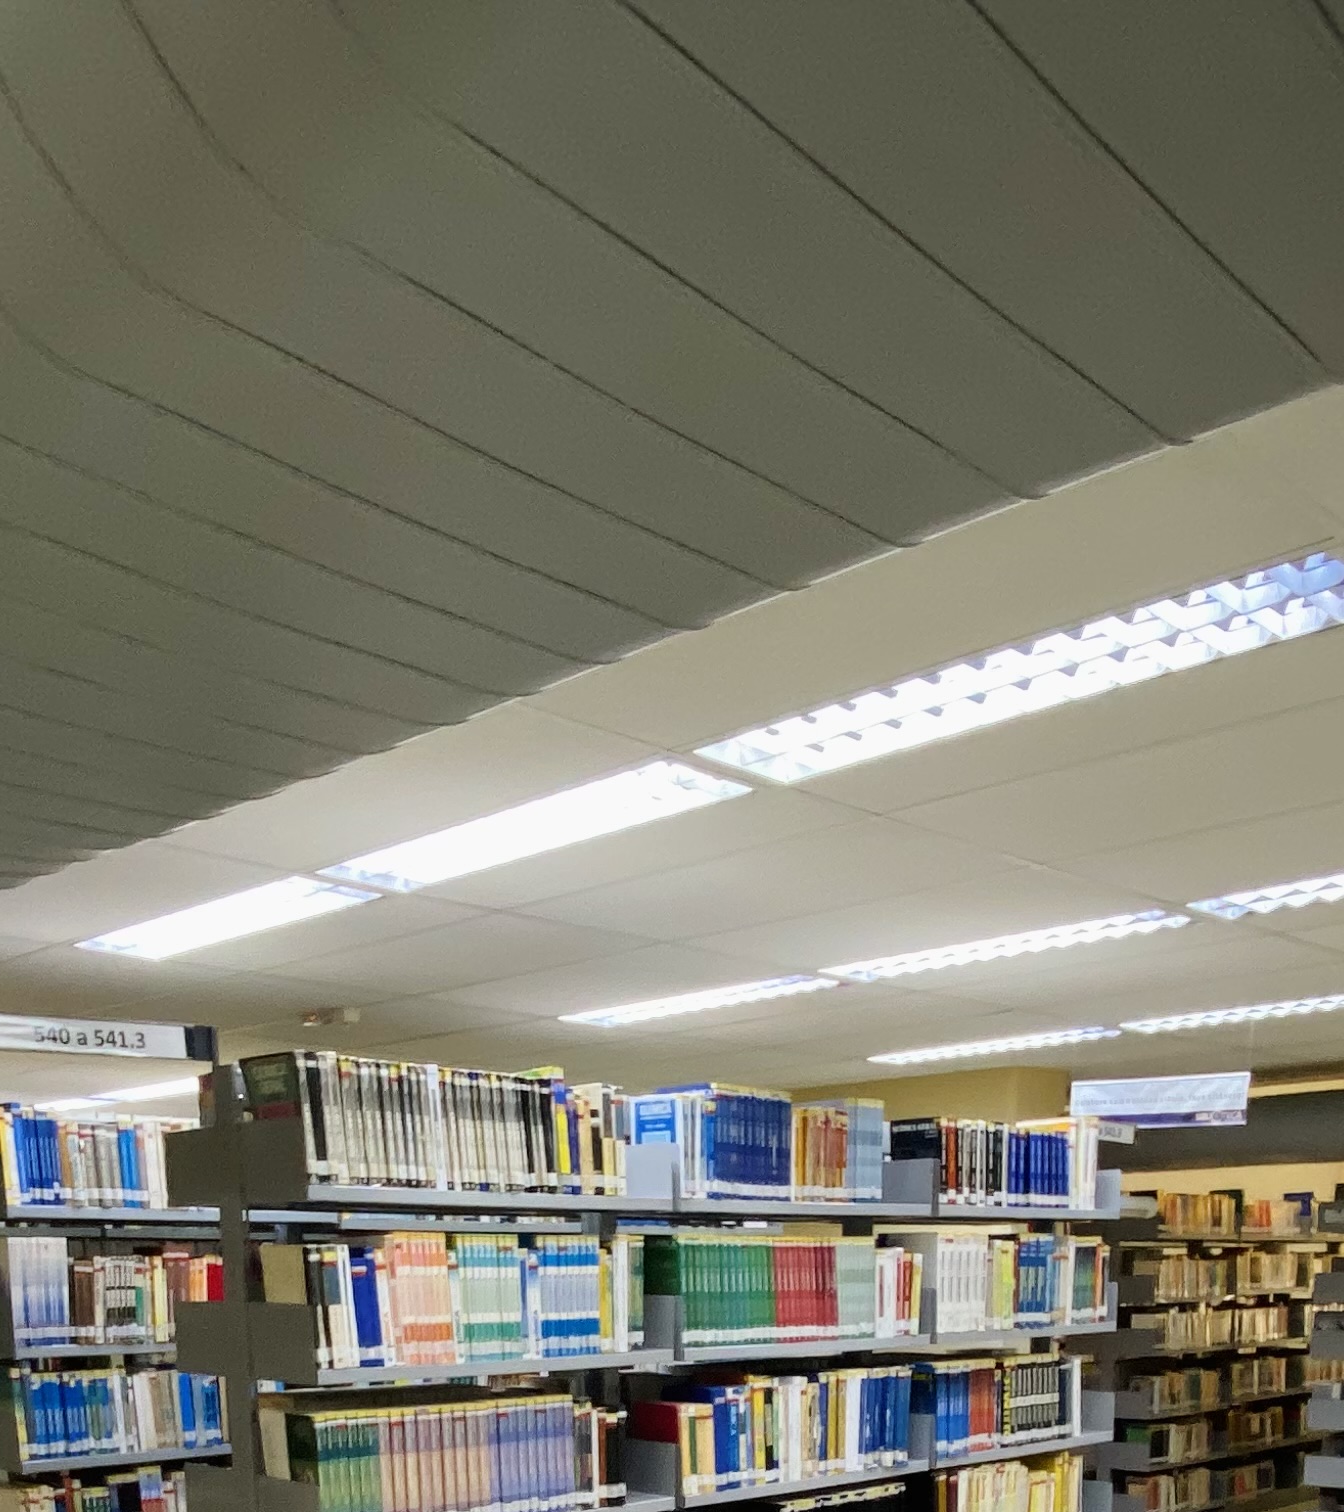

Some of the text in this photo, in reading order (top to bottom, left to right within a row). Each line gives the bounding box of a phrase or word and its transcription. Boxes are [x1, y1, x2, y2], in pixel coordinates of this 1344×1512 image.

[34, 1027, 146, 1049] 540 a 541.3
